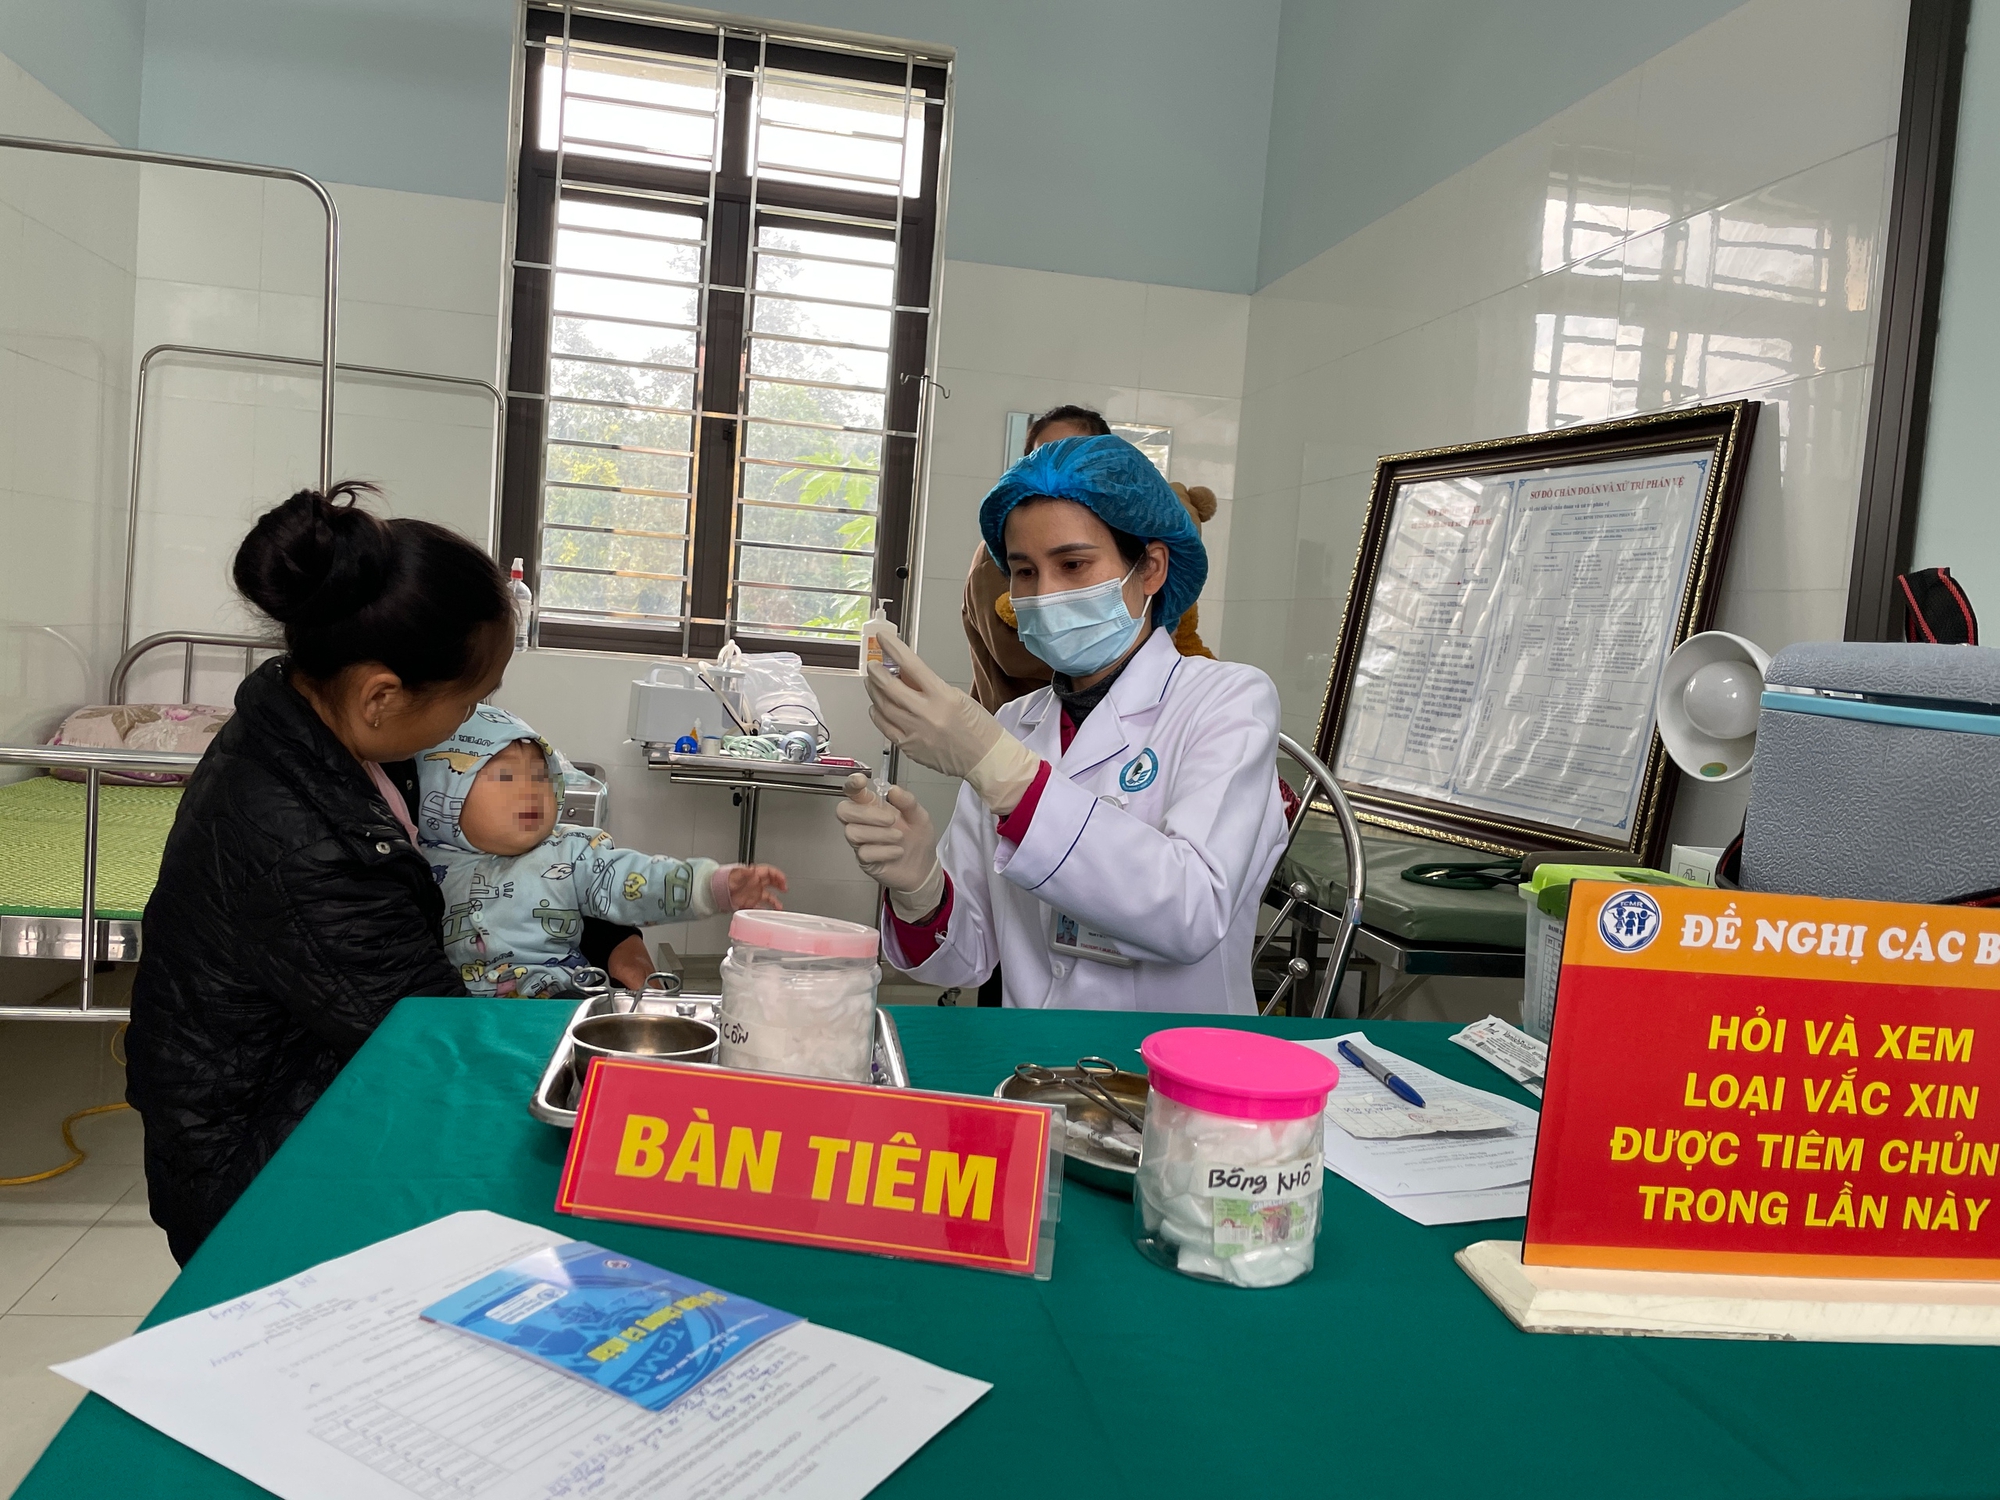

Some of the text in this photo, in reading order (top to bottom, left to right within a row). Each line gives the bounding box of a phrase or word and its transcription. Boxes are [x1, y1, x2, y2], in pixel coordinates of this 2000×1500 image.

[1679, 902, 1742, 950] ĐỀ
[1752, 918, 1868, 965] NGHỊ
[1877, 921, 1967, 963] CÁC
[1707, 1005, 1975, 1063] HỎI VÀ XEM
[1683, 1067, 1980, 1120] LOẠI VẮC XIN
[614, 1108, 998, 1223] BÀN TIÊM
[1610, 1126, 1740, 1171] ĐƯỢC
[1756, 1129, 1865, 1172] TIÊM
[1638, 1180, 1991, 1232] TRONG LẦN NÀY
